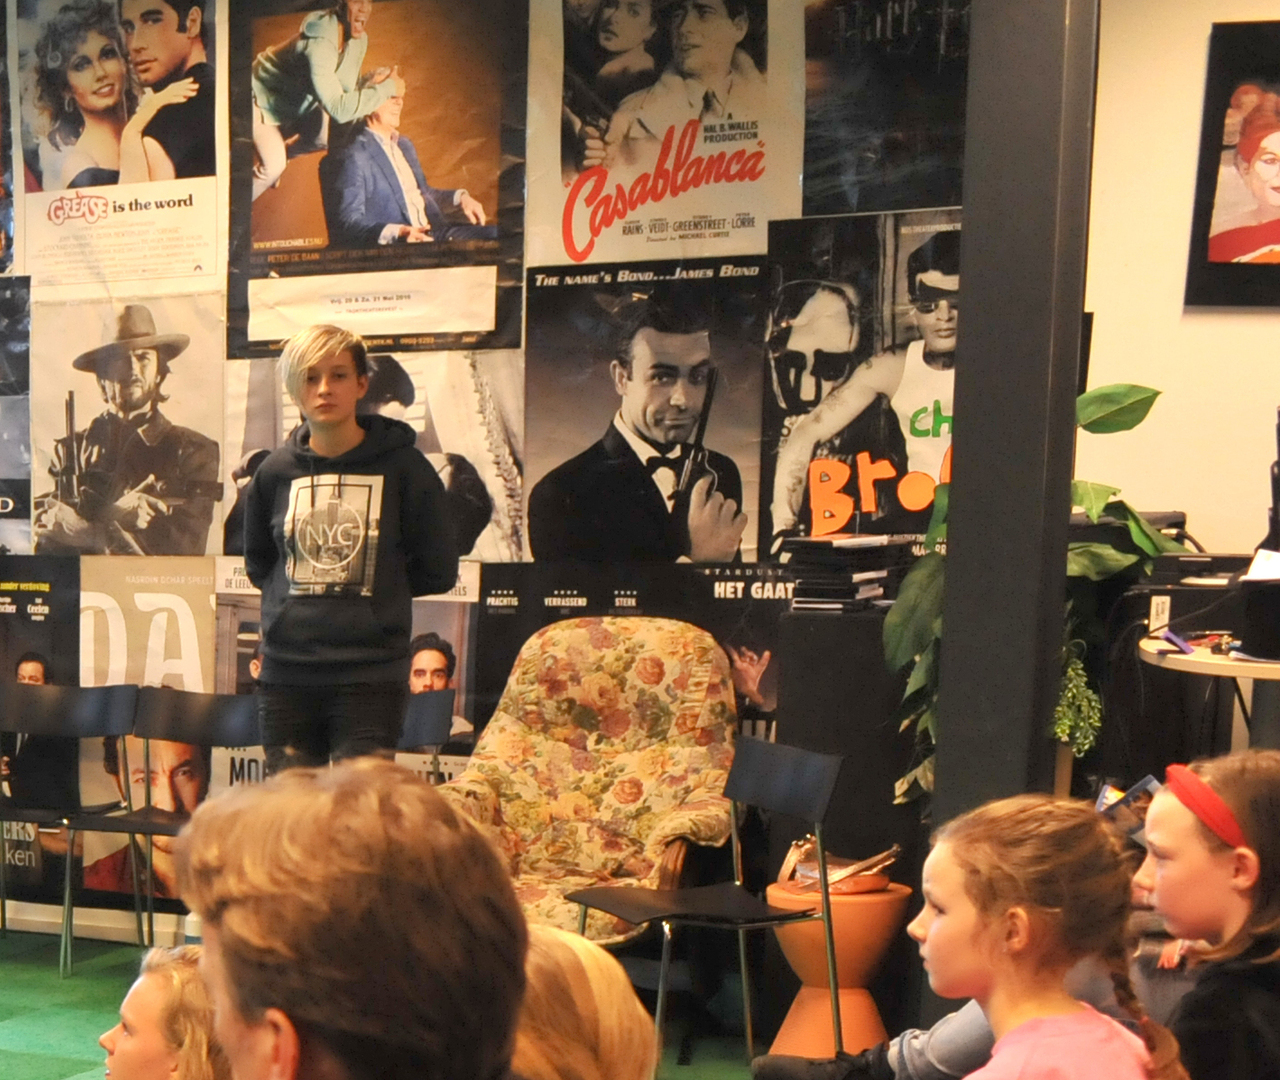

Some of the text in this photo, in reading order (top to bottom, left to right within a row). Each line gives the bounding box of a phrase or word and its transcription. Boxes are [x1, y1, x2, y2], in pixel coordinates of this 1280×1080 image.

[703, 124, 718, 135] HAL
[728, 120, 759, 131] WALLIS
[703, 131, 759, 144] PRODUCTION
[47, 191, 194, 226] GREASE is the word
[622, 217, 756, 236] RAINS VEIDT GREENSTREET LORRE
[535, 274, 559, 286] THE
[719, 264, 760, 278] BOND
[307, 523, 354, 546] NYC
[704, 568, 784, 576] STARDUST
[714, 581, 795, 599] HET GAAT
